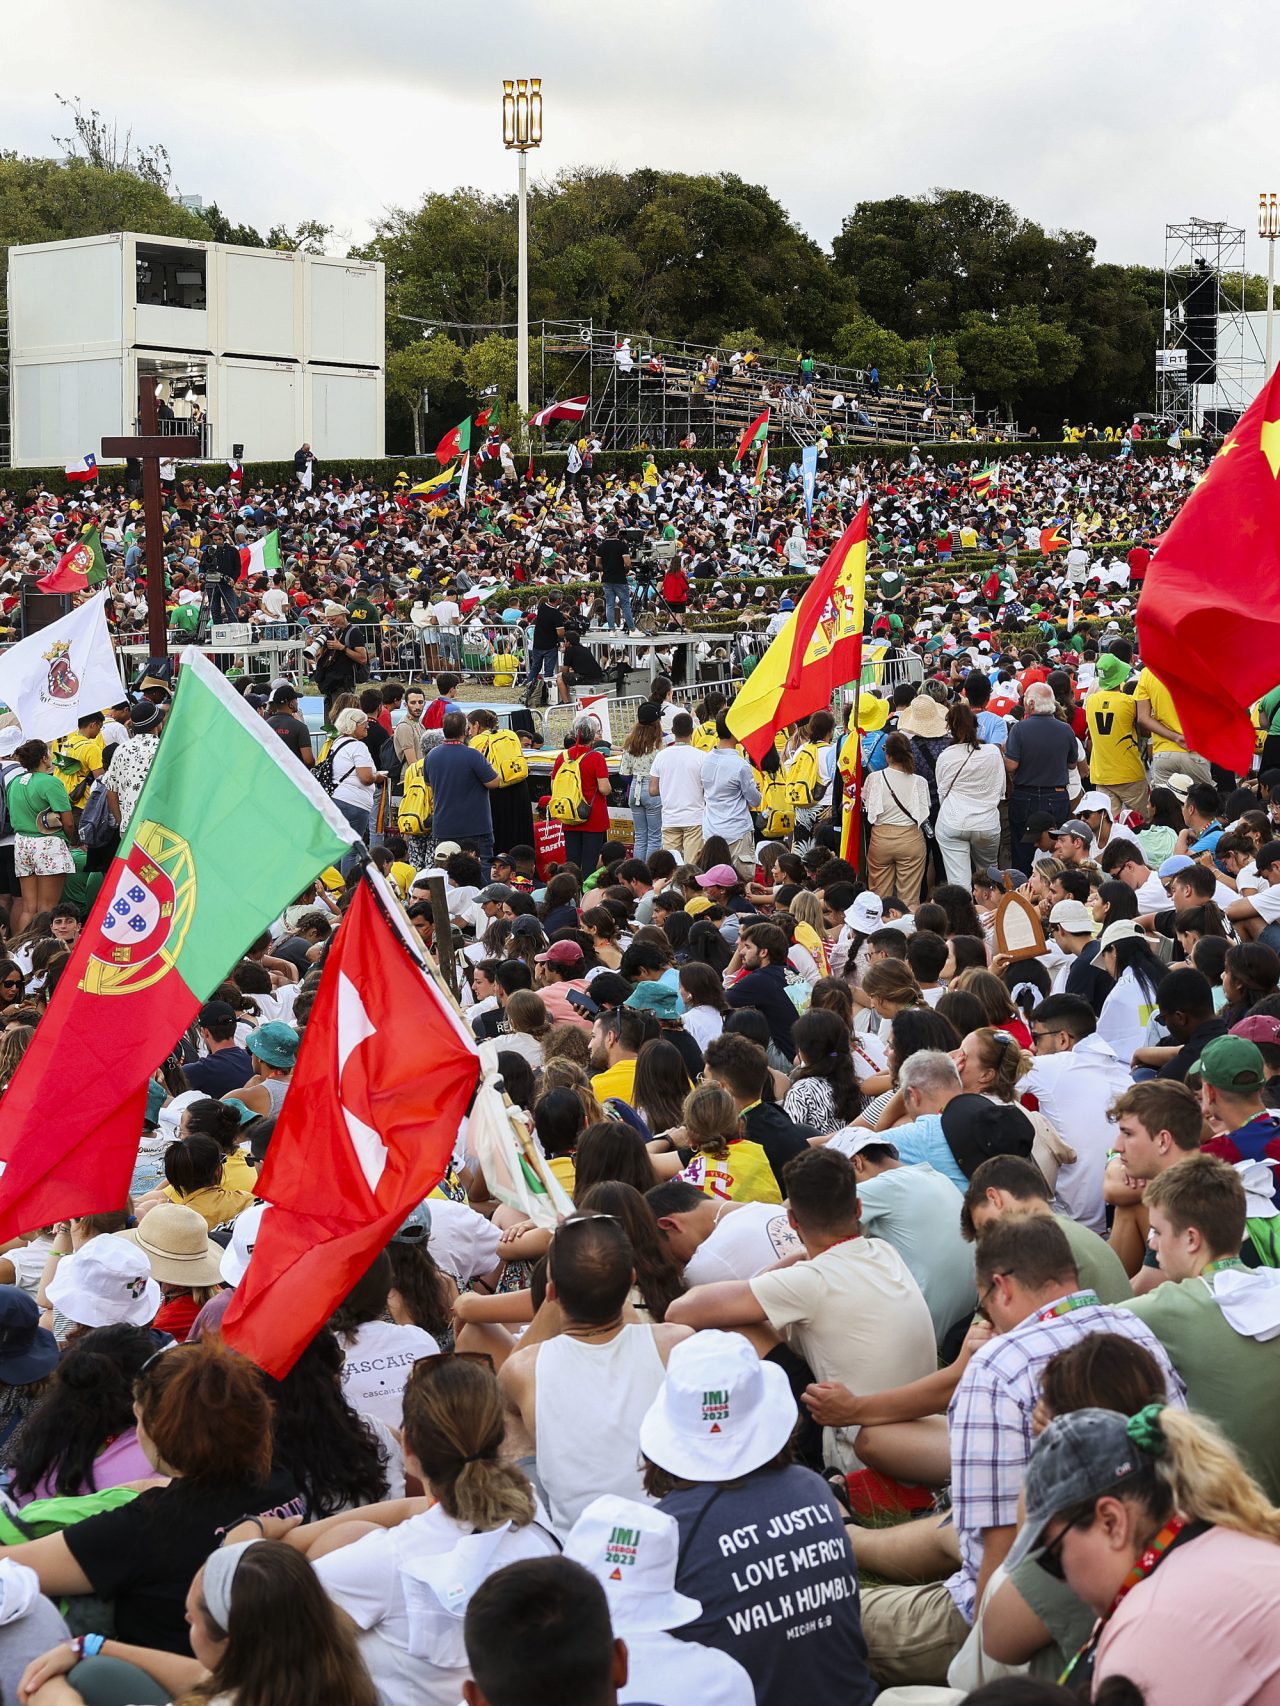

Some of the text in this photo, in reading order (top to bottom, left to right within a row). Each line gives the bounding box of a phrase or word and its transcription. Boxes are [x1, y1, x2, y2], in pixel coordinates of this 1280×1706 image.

[1095, 711, 1115, 736] V
[539, 840, 566, 854] SAFETY
[363, 1386, 405, 1399] cascais.p
[702, 1390, 730, 1405] JMJ
[702, 1411, 730, 1421] 2023
[608, 1526, 641, 1547] JMJ
[718, 1503, 835, 1558] ACT JUSTLY
[605, 1552, 636, 1566] 2023
[606, 1545, 637, 1556] LISBOA
[730, 1537, 847, 1593] LOVE MERCY
[726, 1597, 795, 1637] WALK
[786, 1617, 816, 1641] MICAH
